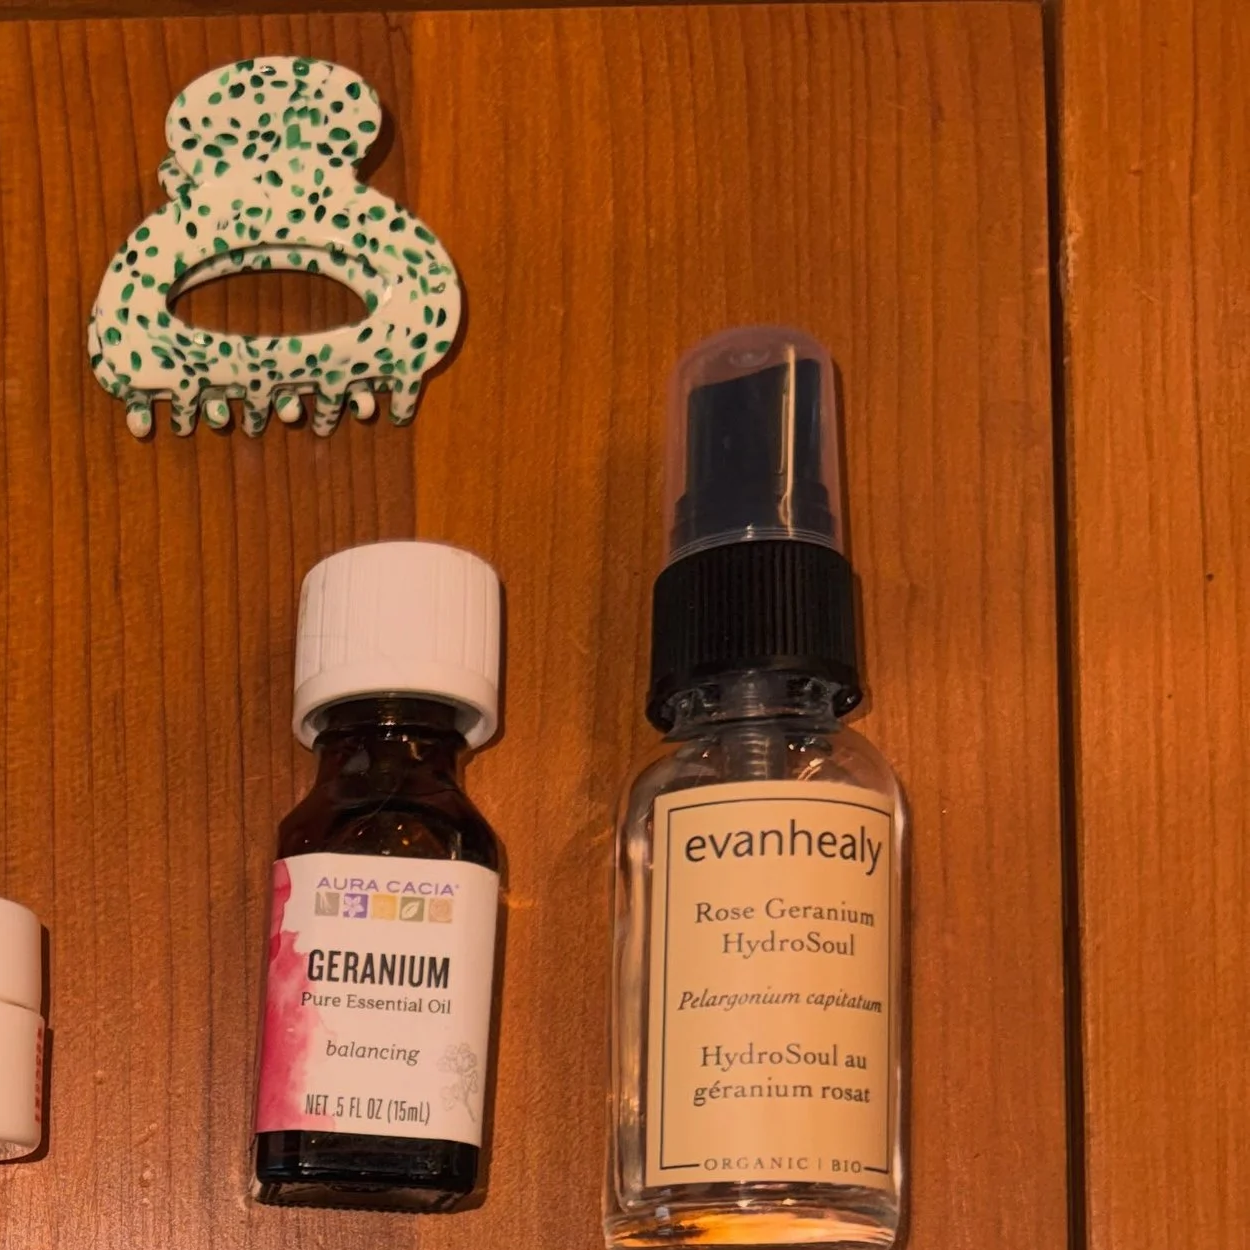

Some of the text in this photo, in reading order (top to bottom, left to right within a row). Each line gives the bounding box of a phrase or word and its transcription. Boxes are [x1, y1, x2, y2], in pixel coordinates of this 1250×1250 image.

[684, 819, 883, 876] evanhealy
[316, 876, 380, 893] AURA
[694, 897, 876, 928] Rose Geranium
[722, 930, 856, 960] HydroSoul
[307, 948, 450, 990] GERANIUM
[301, 991, 451, 1015] Pure Essential Oil
[677, 985, 883, 1014] Pelargonium capitatum
[325, 1039, 420, 1067] balancing
[699, 1043, 868, 1072] HydroSoul au
[692, 1076, 871, 1107] géranium rosat
[305, 1093, 329, 1117] NET
[350, 1097, 362, 1119] FL
[367, 1098, 383, 1120] OZ
[387, 1100, 431, 1125] (15mL)
[704, 1157, 809, 1171] ORGANIC
[831, 1159, 862, 1173] BIO
